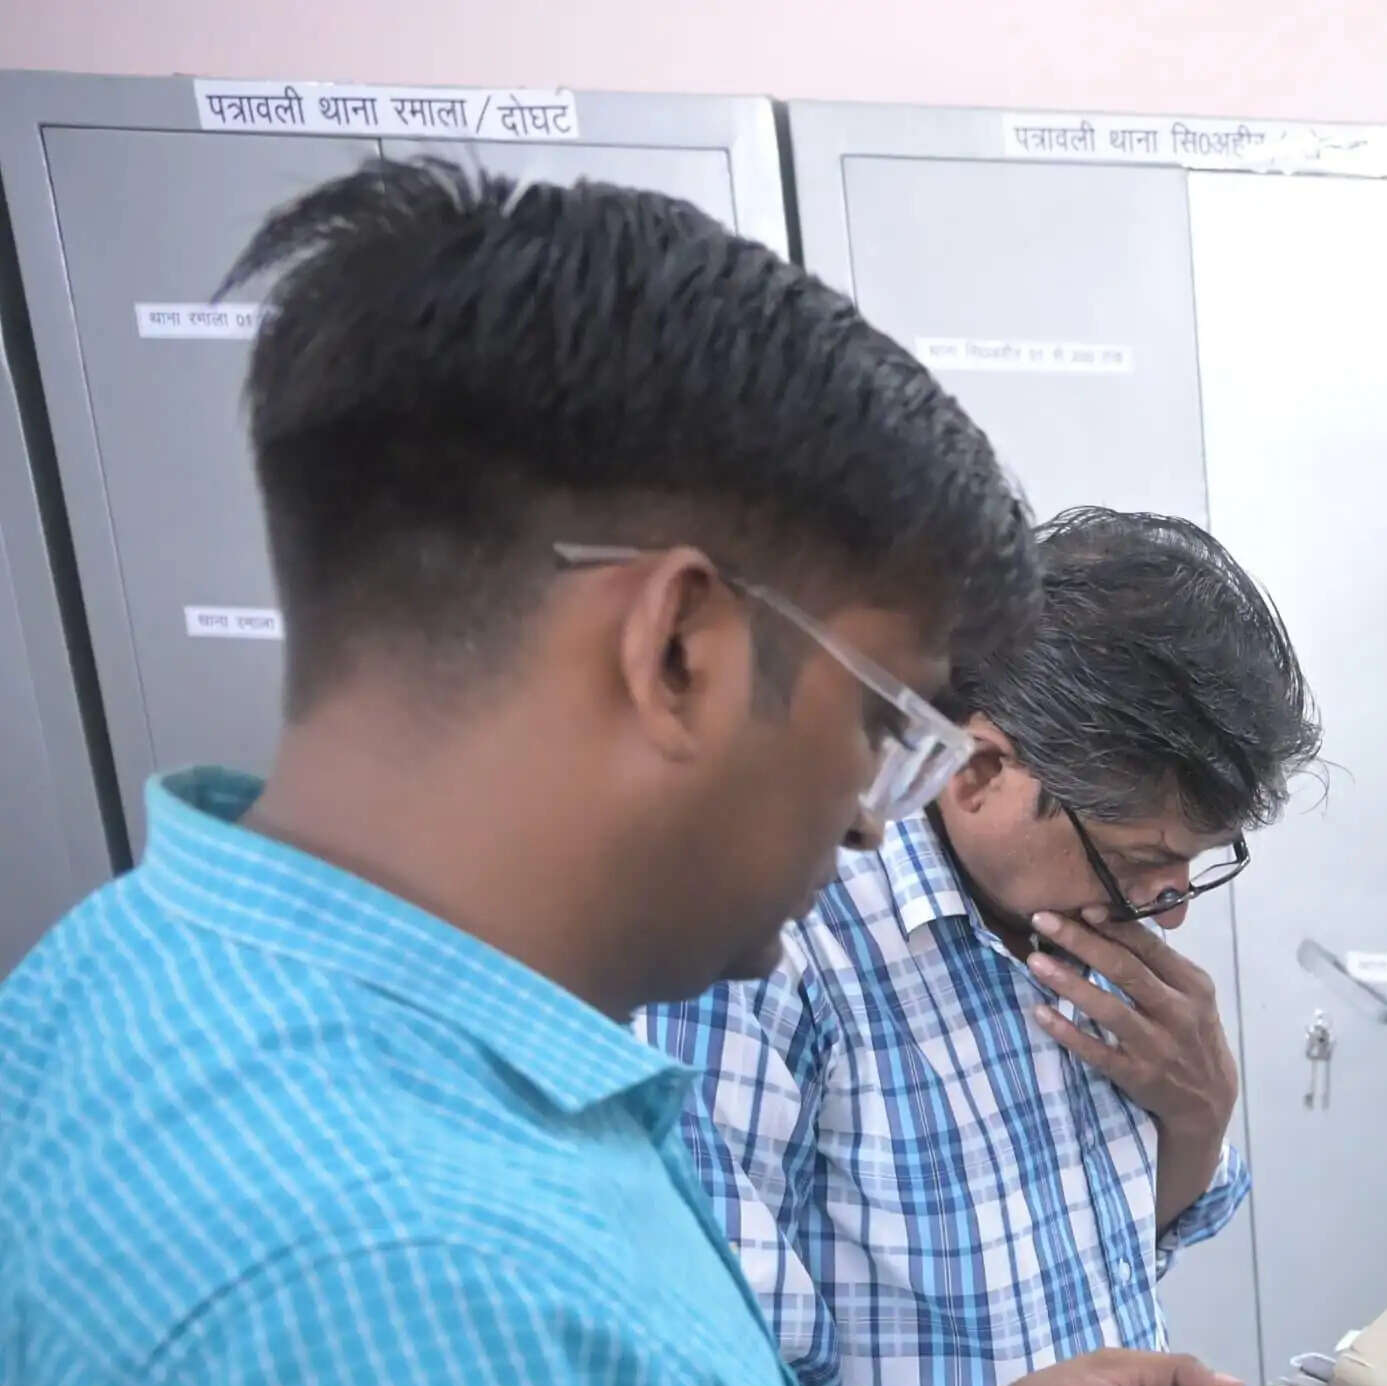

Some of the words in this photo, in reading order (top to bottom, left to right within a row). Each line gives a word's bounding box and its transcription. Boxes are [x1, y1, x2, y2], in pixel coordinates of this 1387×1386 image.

[205, 85, 306, 125] पत्रावली
[318, 96, 378, 126] थाना
[390, 98, 468, 127] रमाला
[1013, 119, 1096, 153] पत्रावली
[1110, 128, 1159, 154] थाना
